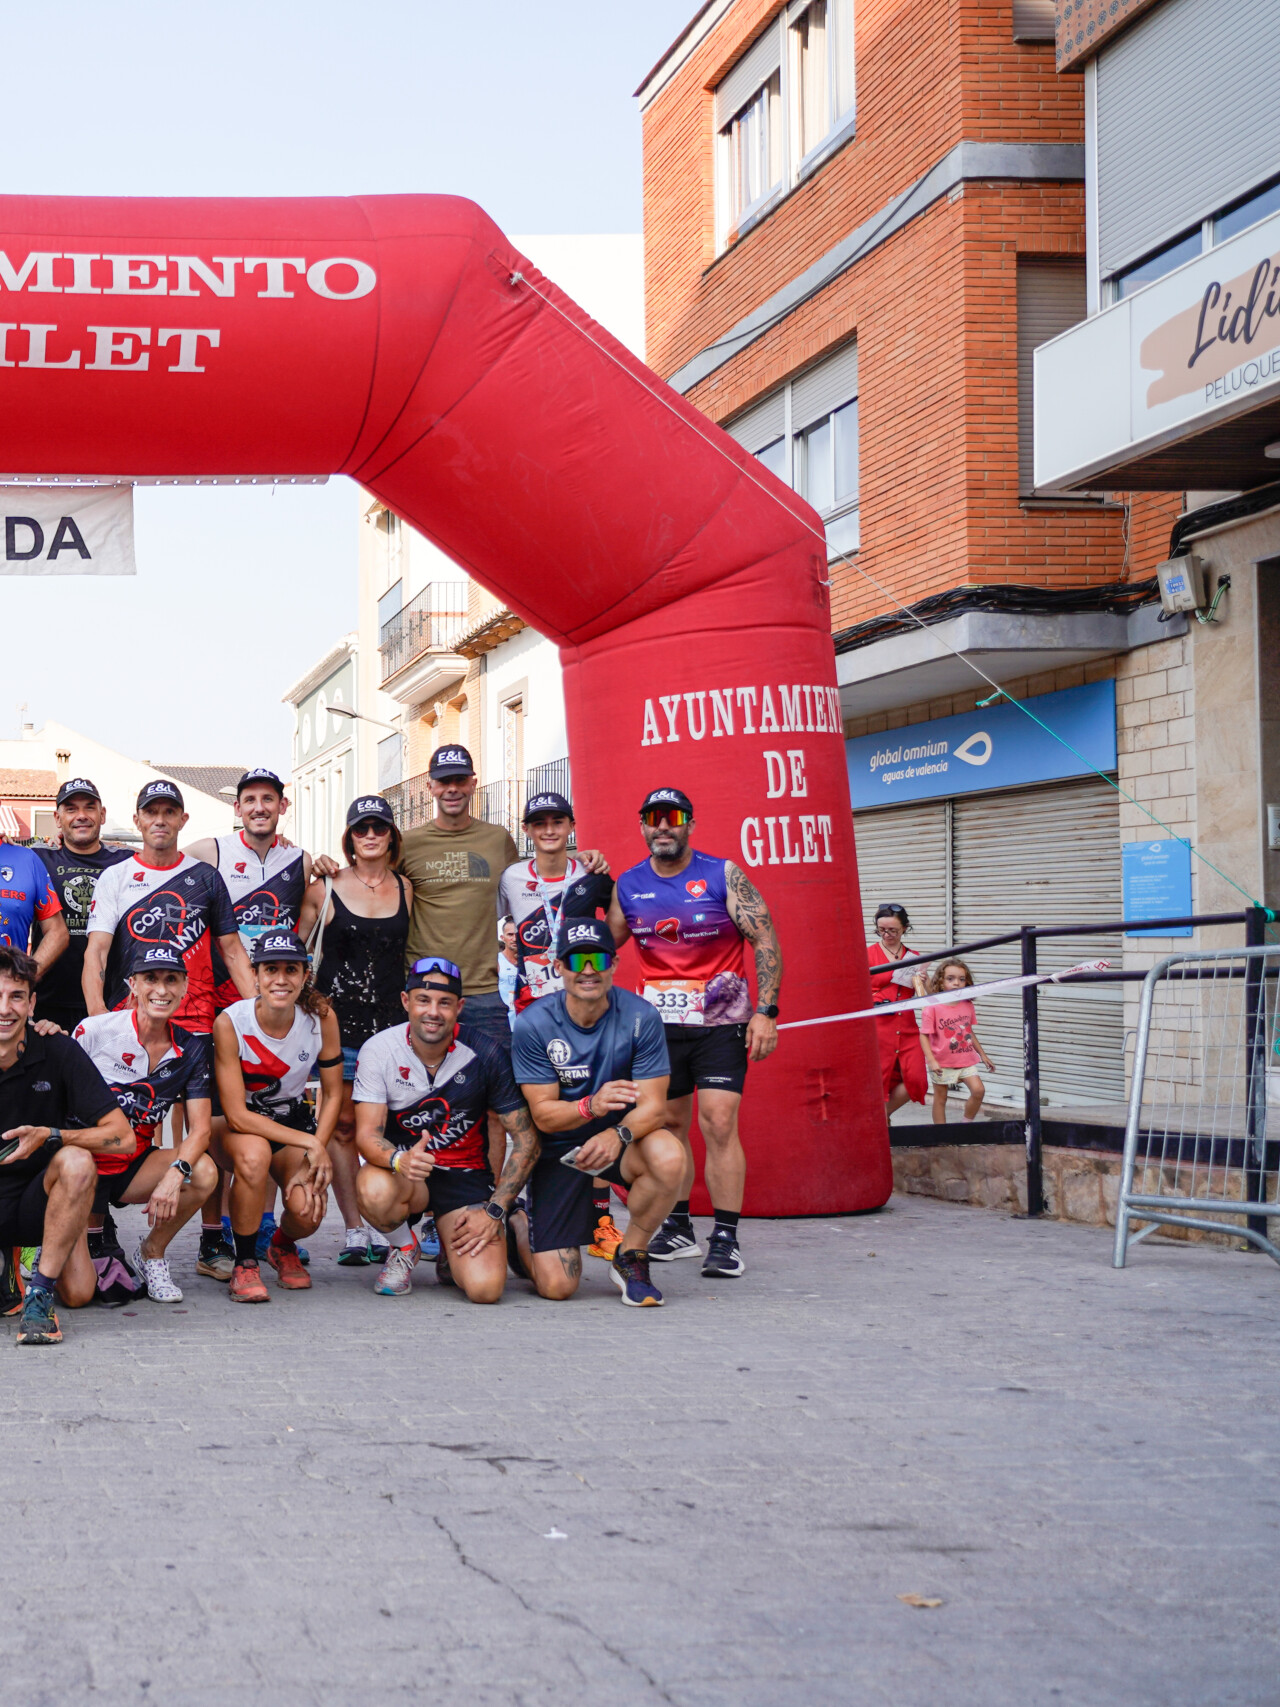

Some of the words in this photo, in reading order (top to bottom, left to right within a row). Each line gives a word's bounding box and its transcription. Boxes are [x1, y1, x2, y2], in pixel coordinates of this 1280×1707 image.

[1187, 257, 1280, 369] Lidi
[641, 685, 843, 746] AYUNTAMIENT
[438, 749, 466, 764] E&L
[869, 747, 902, 773] global
[902, 739, 949, 763] omnium
[763, 750, 807, 799] DE
[881, 768, 904, 786] aguas
[905, 765, 916, 780] de
[915, 760, 949, 779] valencia
[65, 779, 92, 791] E&L
[146, 782, 176, 795] E&L
[357, 799, 384, 811] E&L
[528, 796, 558, 809] E&L
[739, 814, 833, 868] GILET
[443, 851, 468, 861] THE
[425, 860, 469, 871] NORTH
[438, 869, 469, 878] FACE
[133, 906, 166, 934] COR
[567, 924, 601, 941] E&L
[264, 935, 297, 949] E&L
[145, 948, 178, 960] E&L
[656, 992, 688, 1008] 333
[402, 1110, 432, 1128] COR
